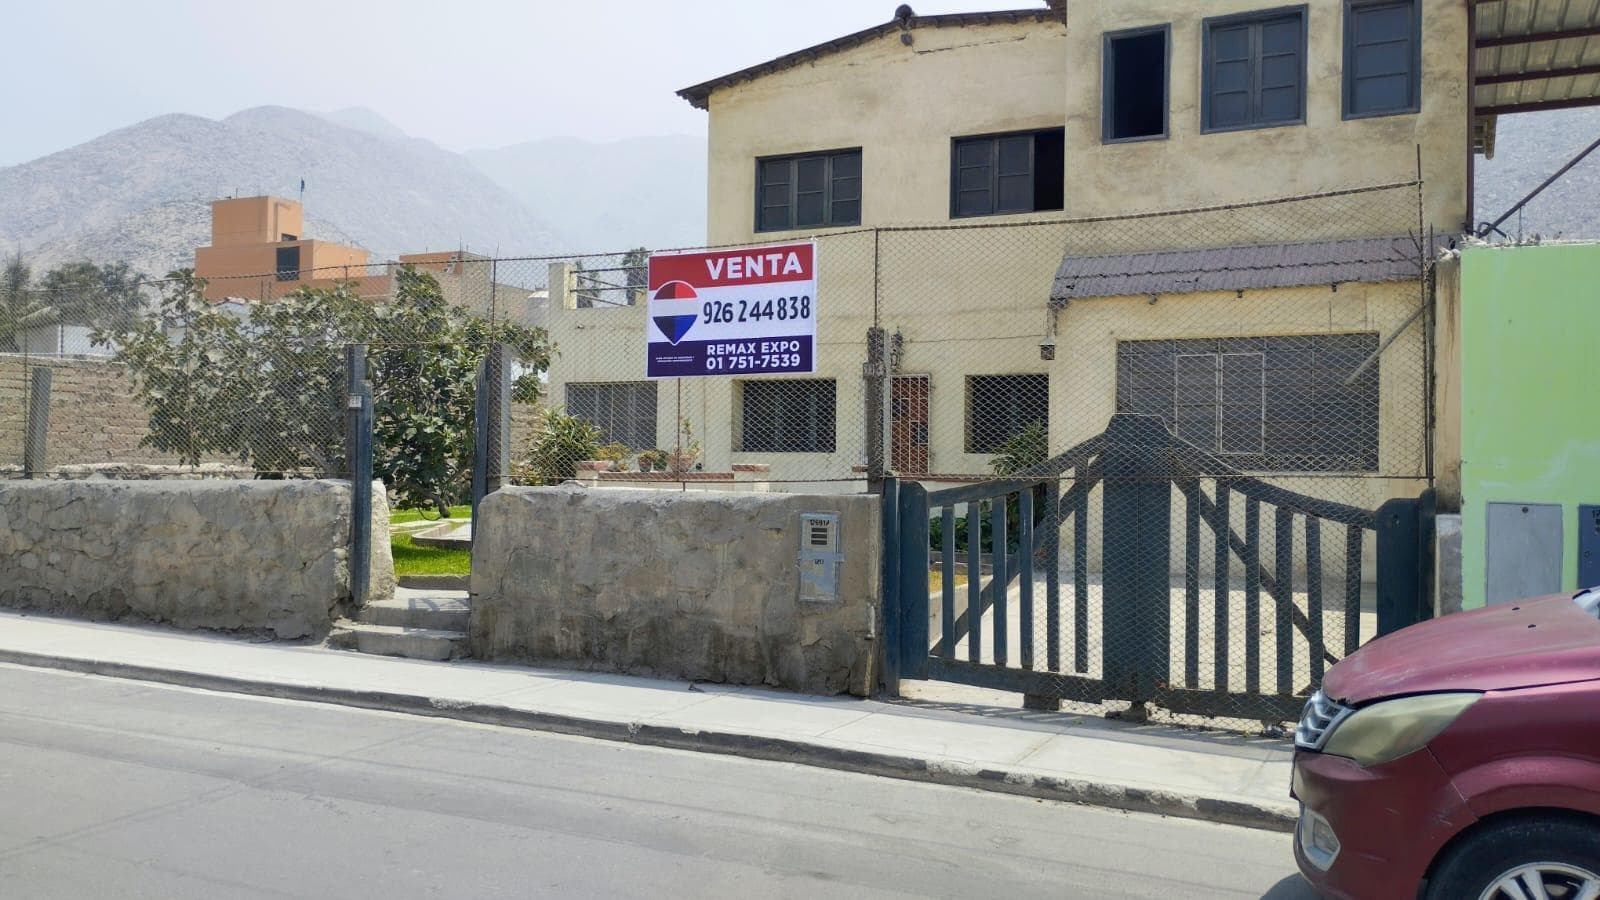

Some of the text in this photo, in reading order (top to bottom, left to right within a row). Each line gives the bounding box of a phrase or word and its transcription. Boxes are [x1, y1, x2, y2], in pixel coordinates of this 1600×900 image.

[705, 252, 803, 280] VENTA
[706, 341, 800, 355] REMAX EXPO
[706, 358, 723, 370] 01
[728, 354, 801, 370] 751-7539
